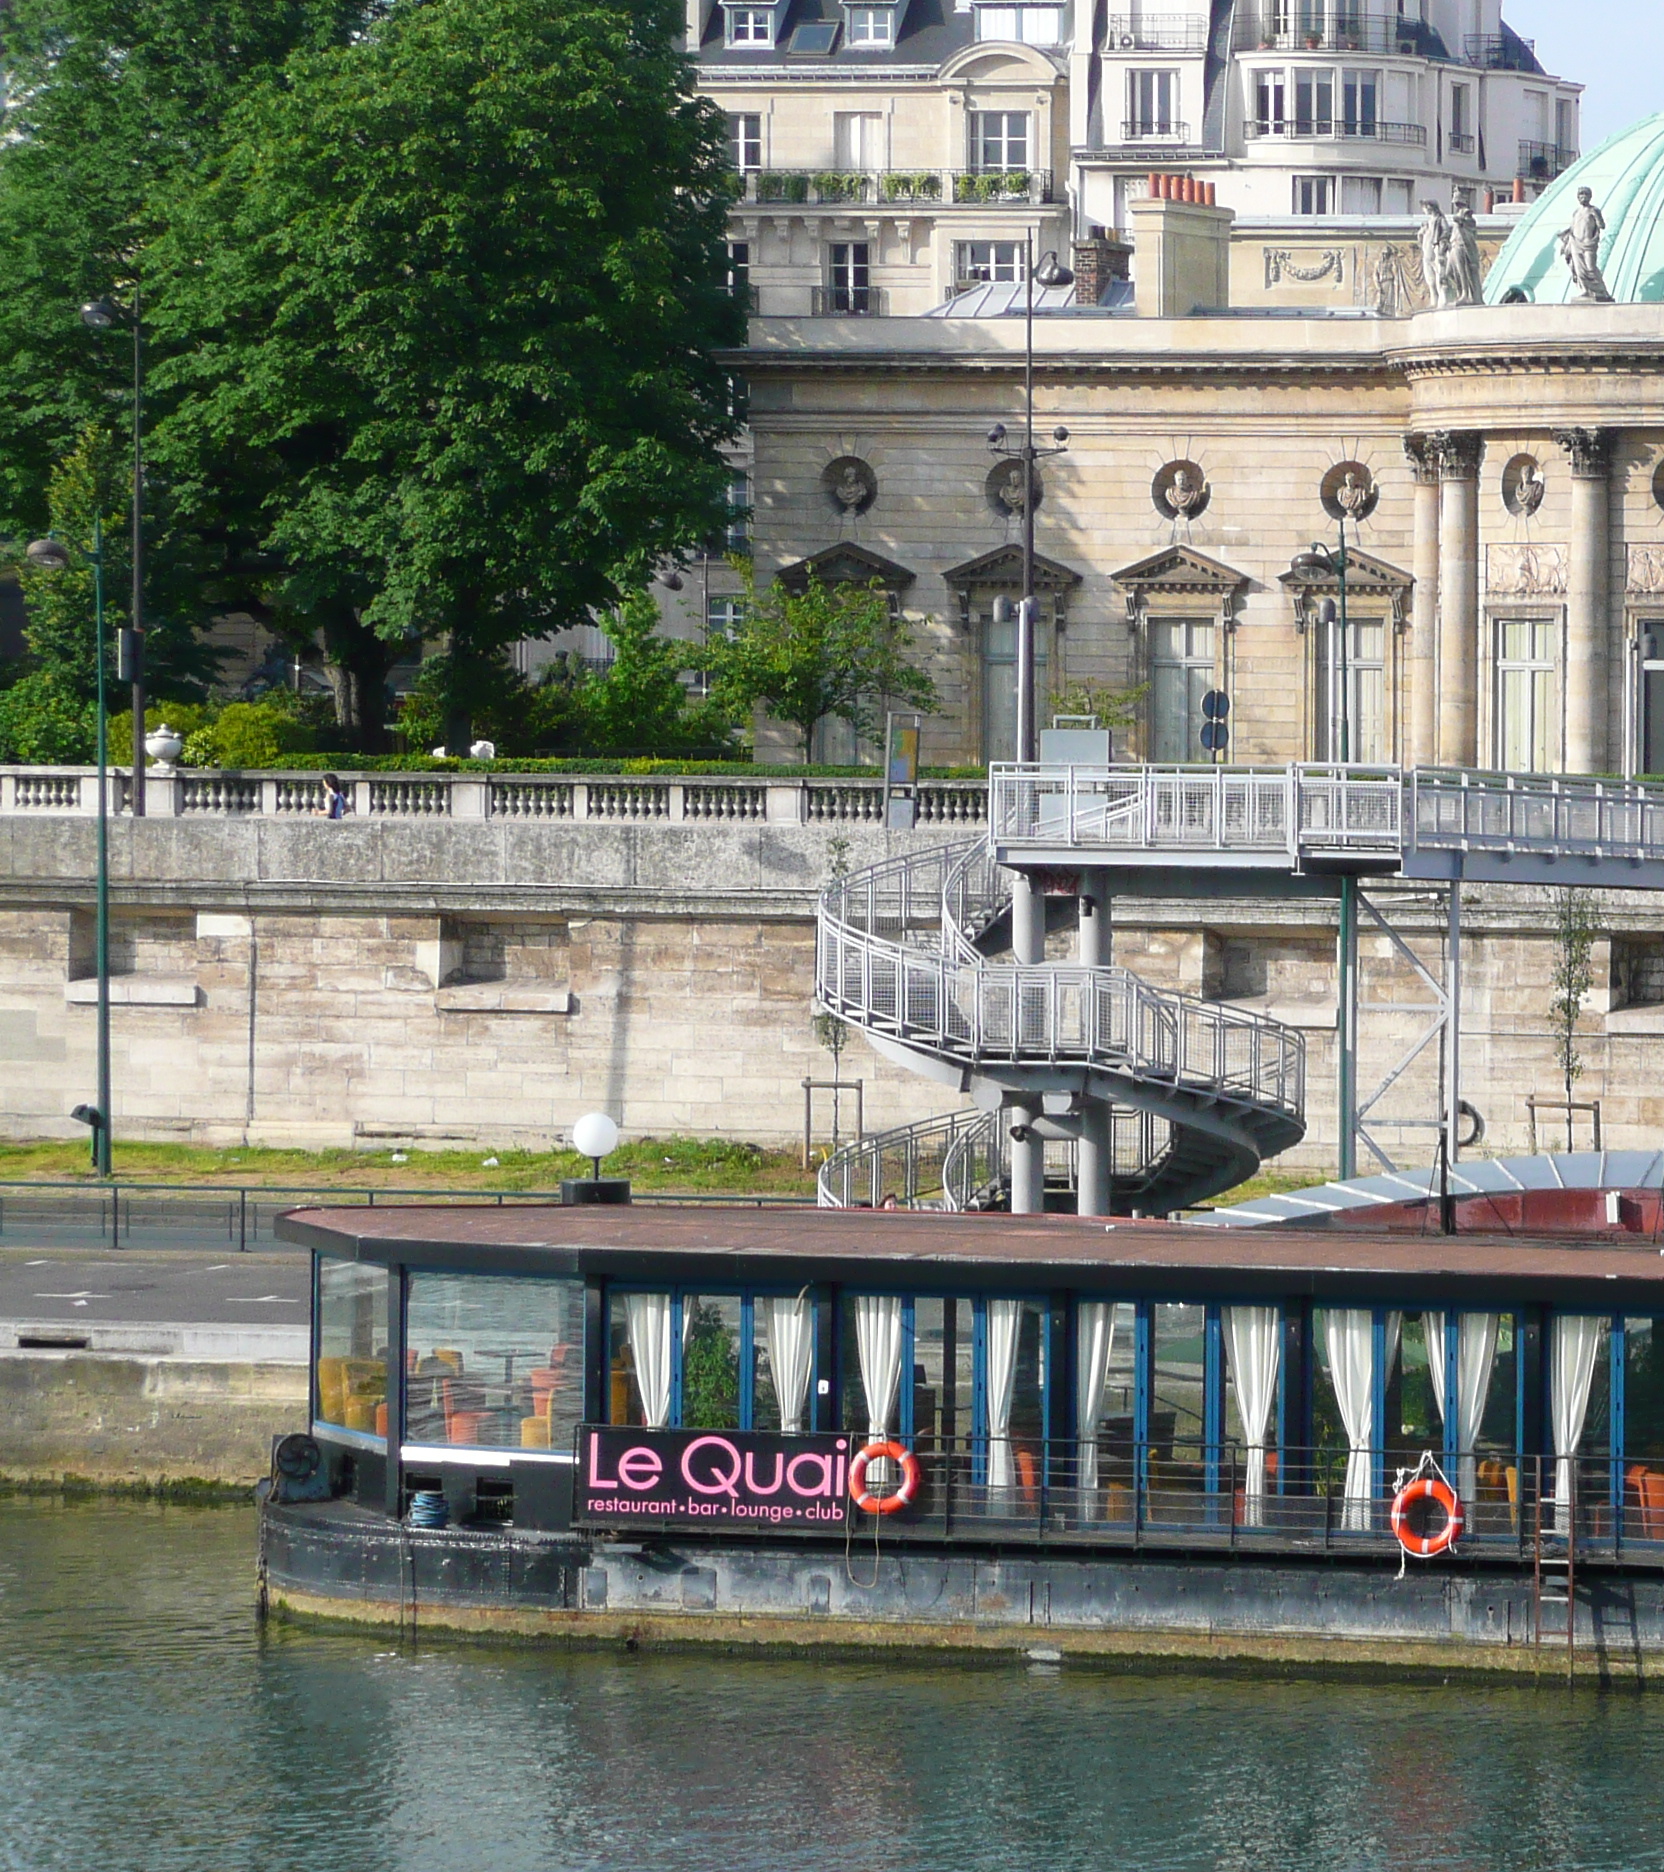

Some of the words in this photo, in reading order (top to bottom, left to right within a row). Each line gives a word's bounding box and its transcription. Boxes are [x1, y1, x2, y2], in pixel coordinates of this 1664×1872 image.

[589, 1432, 662, 1491] Le
[681, 1435, 846, 1498] Quai
[587, 1497, 676, 1515] restaurant
[688, 1497, 720, 1516] bar
[731, 1498, 794, 1522] lounge
[805, 1501, 844, 1521] club
